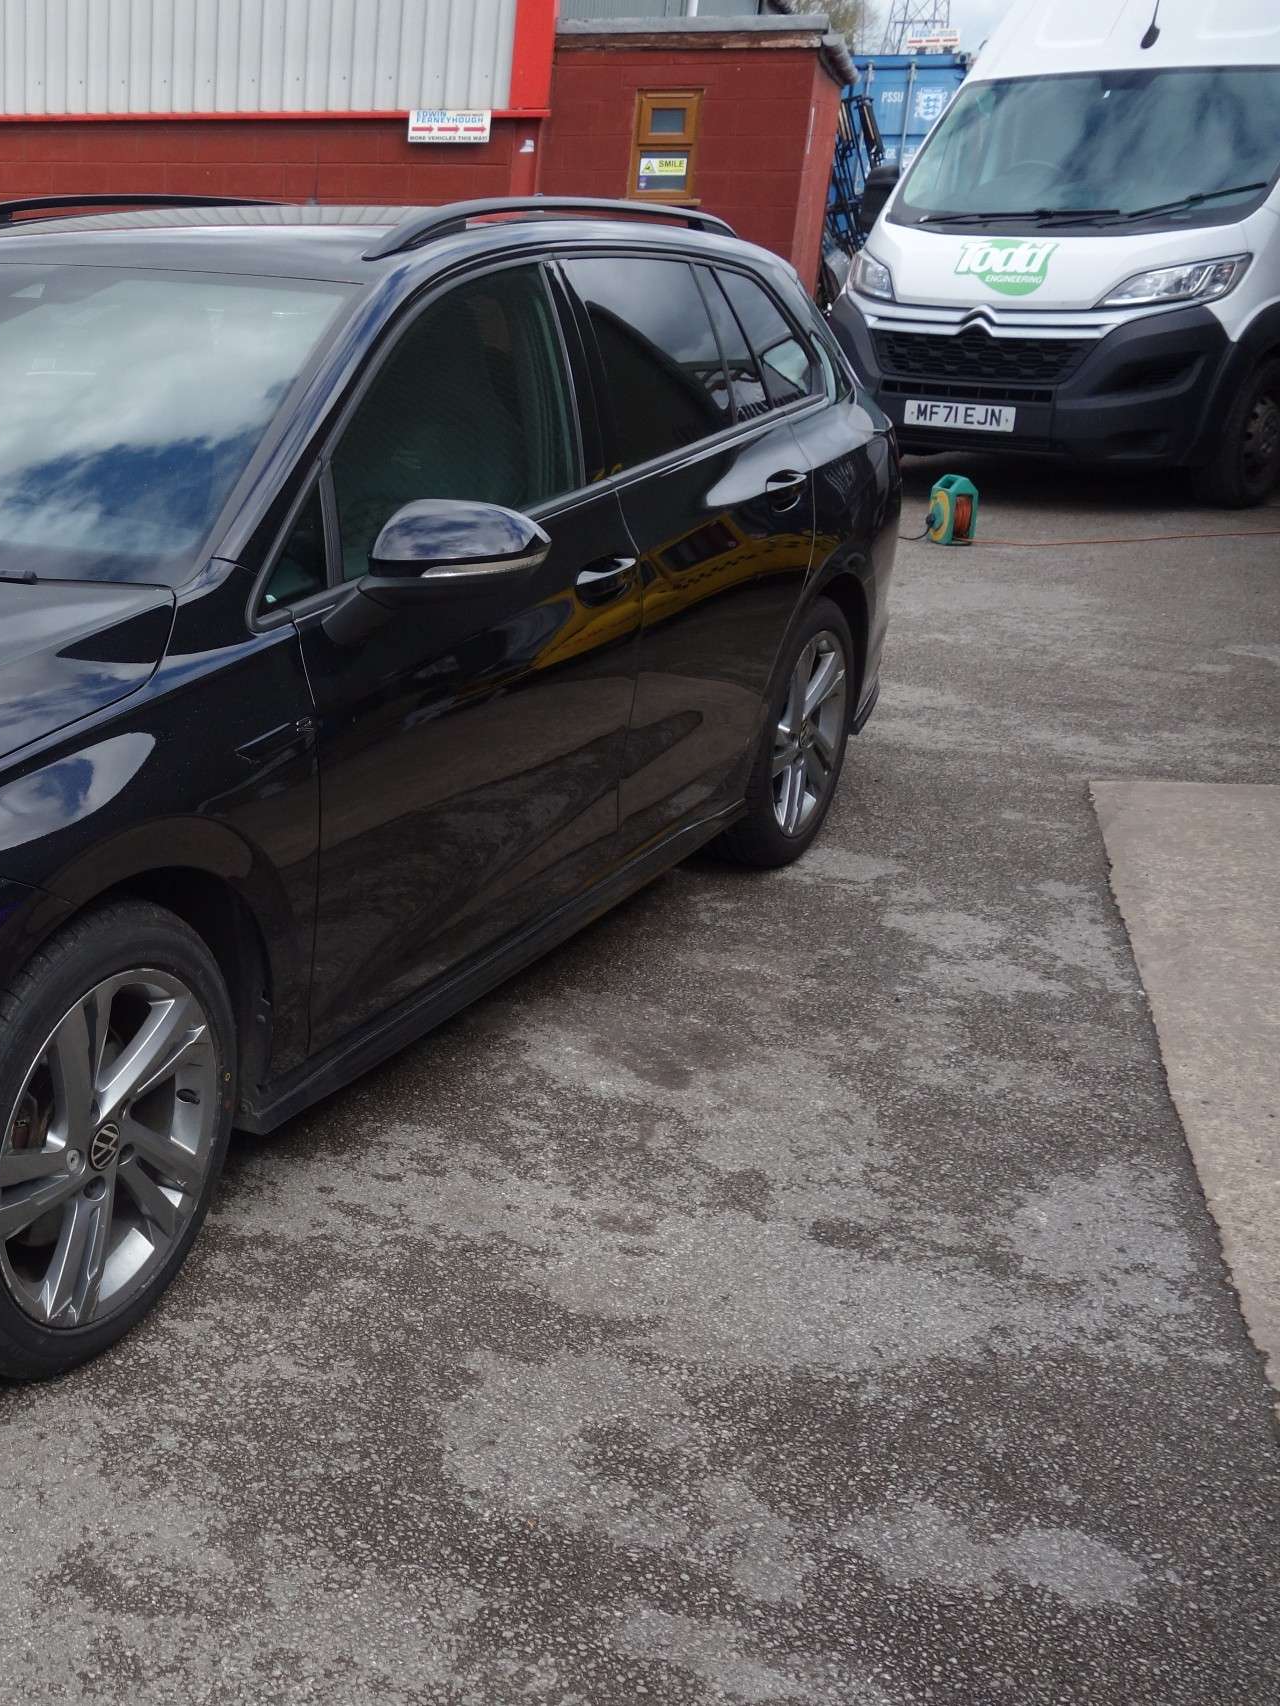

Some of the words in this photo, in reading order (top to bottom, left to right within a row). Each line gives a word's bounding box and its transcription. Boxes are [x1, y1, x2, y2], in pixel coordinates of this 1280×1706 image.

[881, 91, 904, 103] PSSU
[659, 160, 684, 168] SMILE
[955, 241, 1060, 274] Todd
[986, 274, 1042, 284] ENGINEERING
[916, 404, 959, 424] MF71
[963, 407, 1003, 427] EJN
